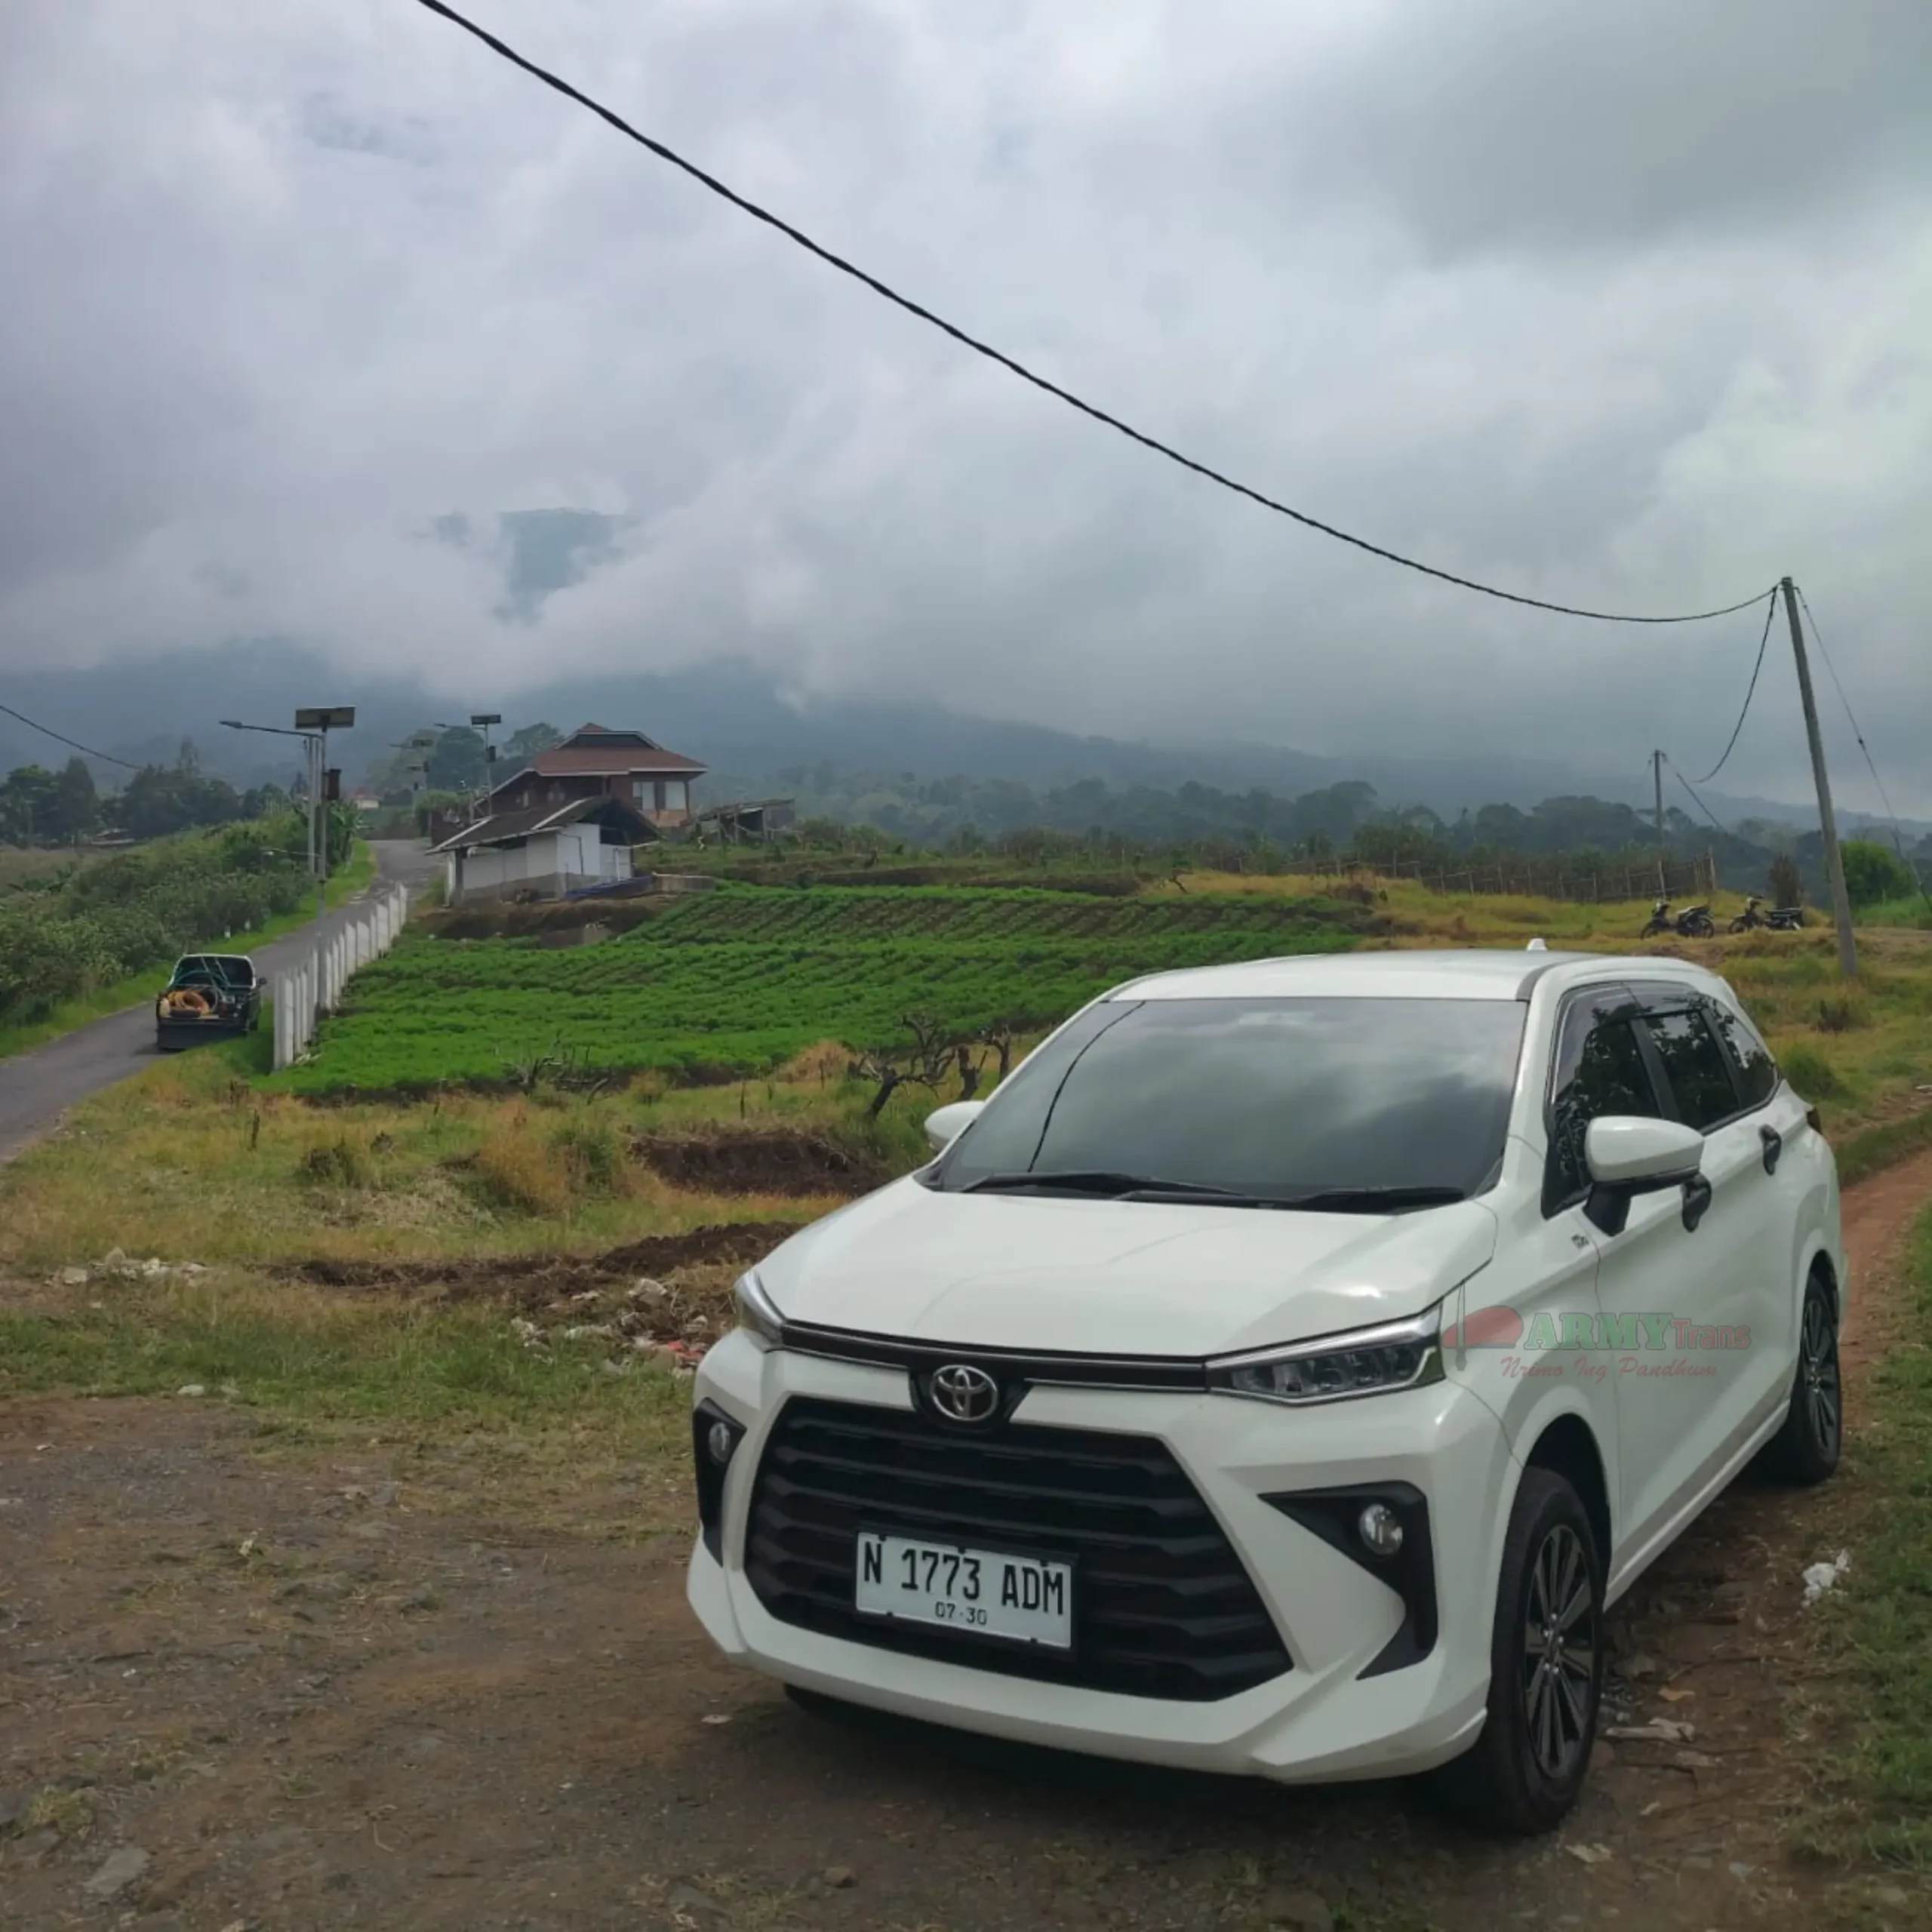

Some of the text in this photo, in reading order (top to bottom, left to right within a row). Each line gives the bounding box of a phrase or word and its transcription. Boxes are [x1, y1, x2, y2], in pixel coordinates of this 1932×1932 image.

[864, 1542, 1063, 1615] N 1773 ADM
